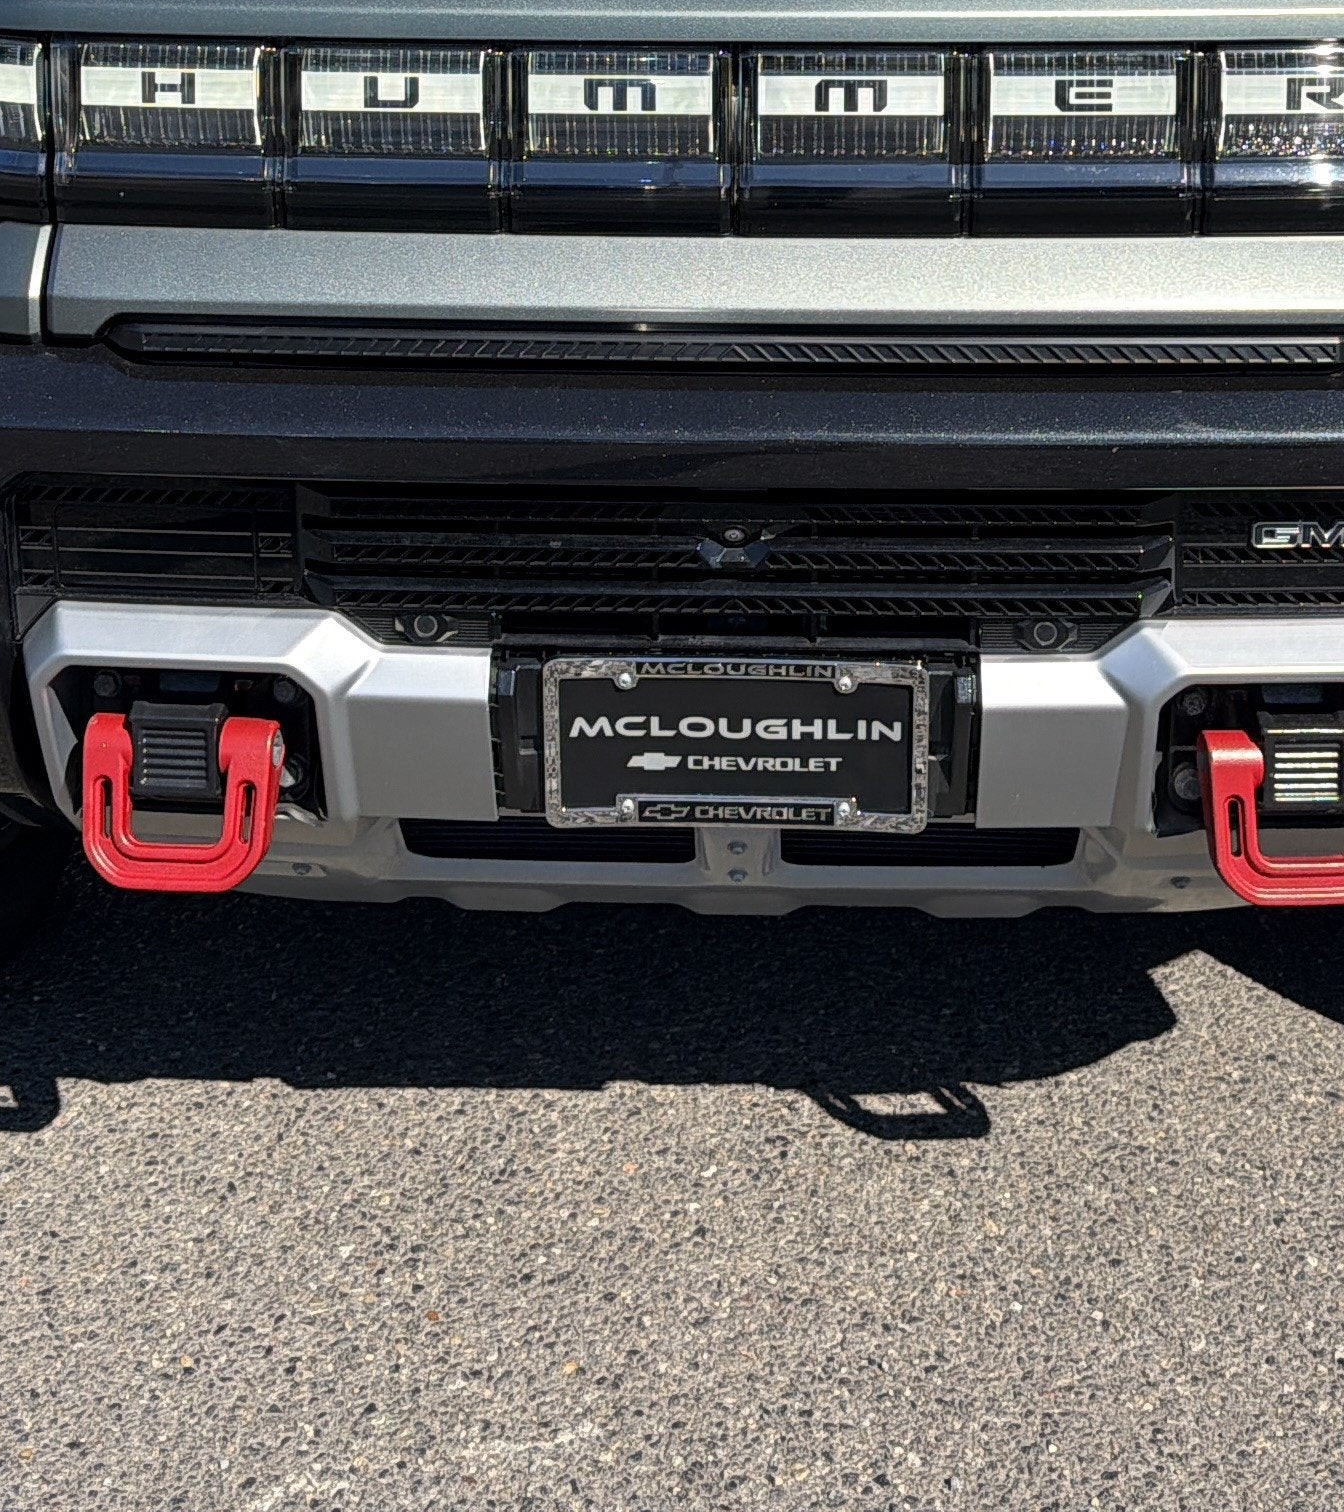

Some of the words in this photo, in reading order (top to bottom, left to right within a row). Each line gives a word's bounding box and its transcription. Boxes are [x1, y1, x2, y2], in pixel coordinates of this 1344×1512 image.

[640, 662, 833, 678] MCLOUGHLIN
[568, 715, 903, 743] MCLOUGHLIN
[687, 755, 844, 773] CHEVROLET
[694, 805, 832, 821] CHEVROLET
